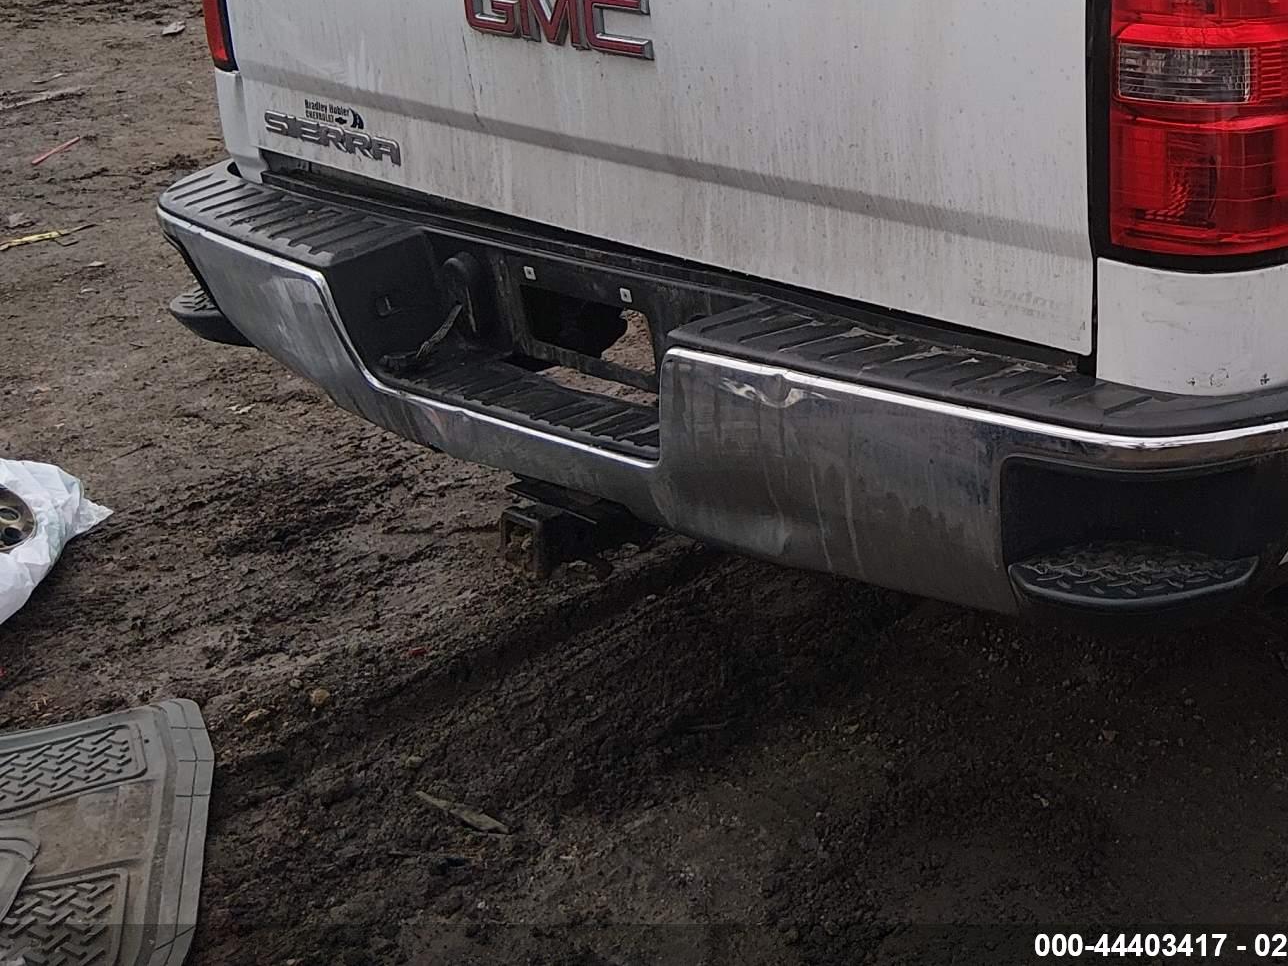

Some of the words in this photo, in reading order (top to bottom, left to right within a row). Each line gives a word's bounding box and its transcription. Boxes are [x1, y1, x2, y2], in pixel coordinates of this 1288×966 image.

[304, 98, 328, 114] Bradley
[305, 109, 335, 123] CHEVROLET
[264, 109, 402, 167] SIERRA
